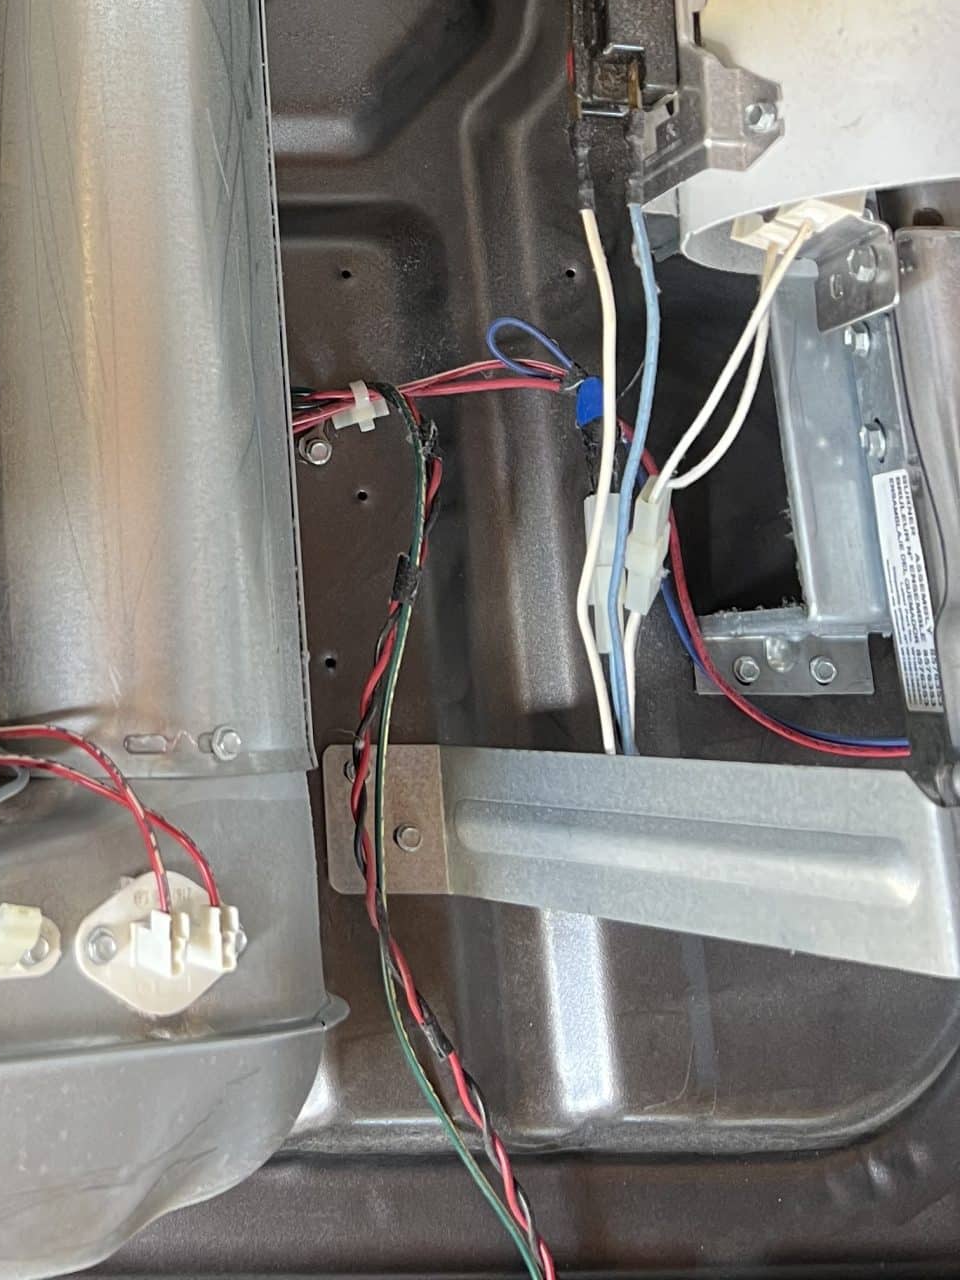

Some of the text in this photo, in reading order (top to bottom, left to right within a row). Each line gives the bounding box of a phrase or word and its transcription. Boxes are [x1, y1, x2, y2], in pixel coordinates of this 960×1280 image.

[888, 477, 904, 550] ENSAMBLAJE
[894, 476, 910, 543] BRULEUR
[908, 563, 926, 641] ENSEMBLE
[899, 553, 908, 575] DEL
[901, 474, 916, 536] BURNER
[913, 552, 932, 634] ASSEMBLY
[903, 577, 919, 643] QUEMADOR
